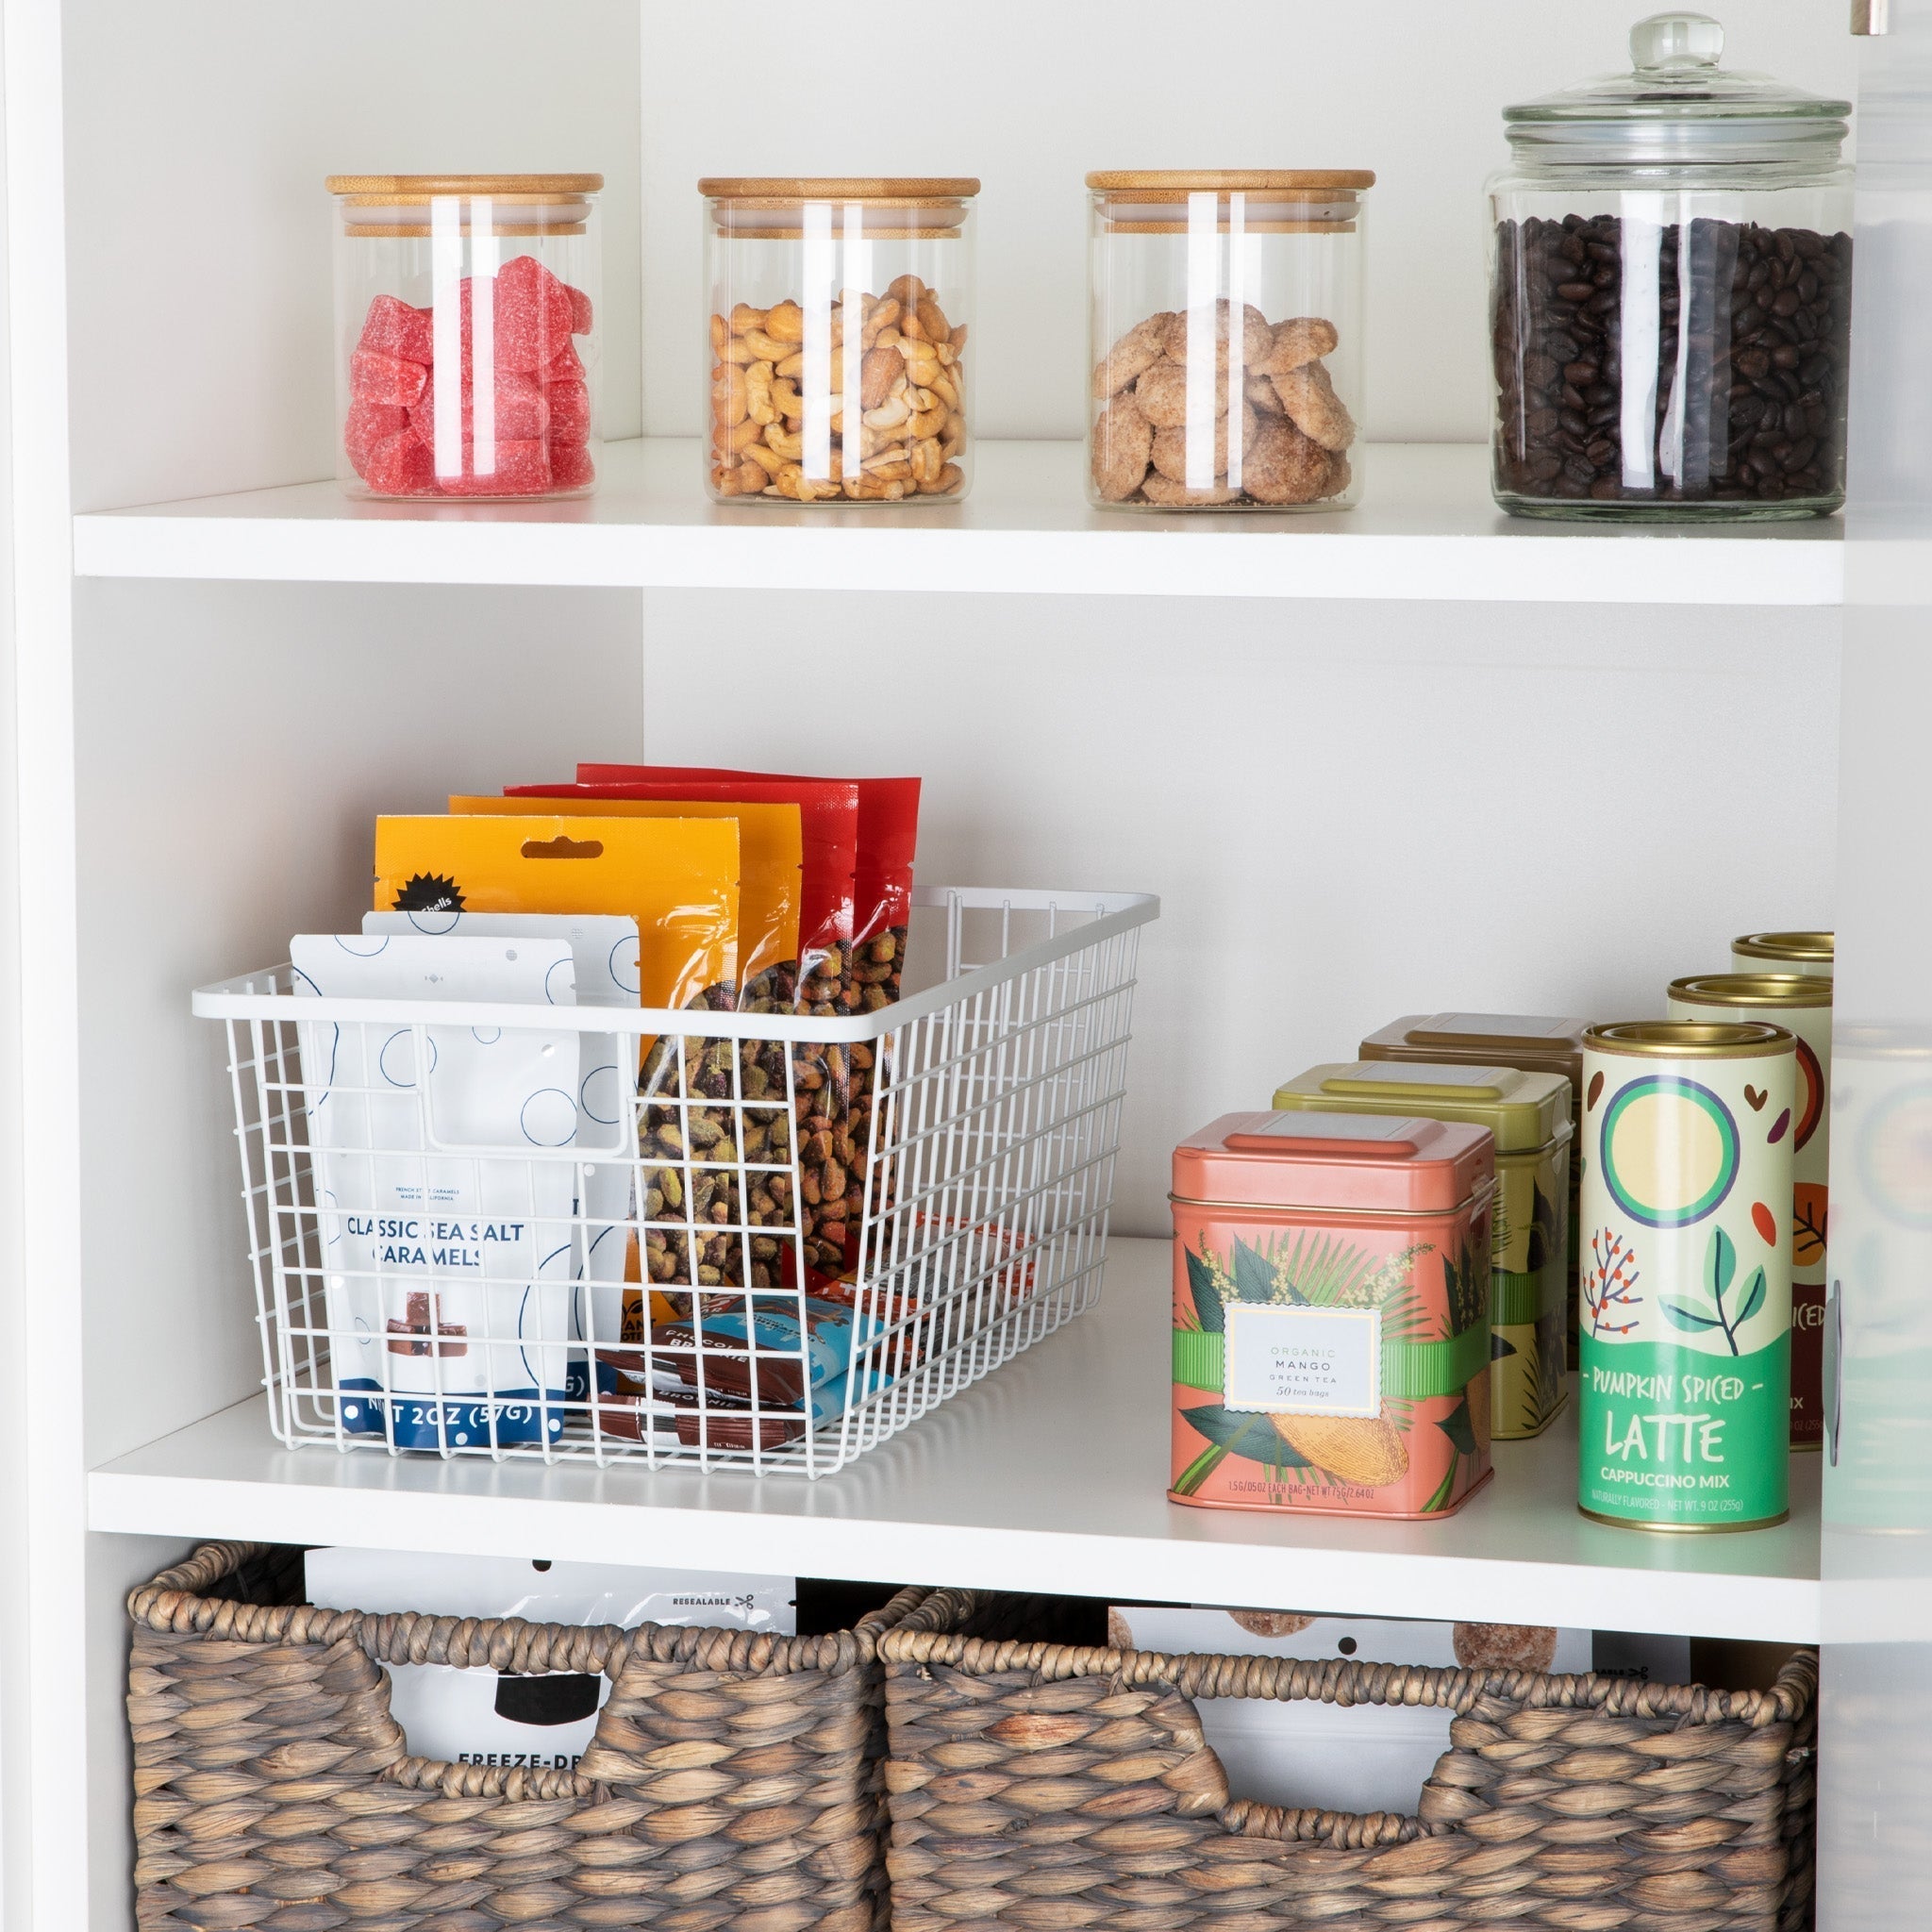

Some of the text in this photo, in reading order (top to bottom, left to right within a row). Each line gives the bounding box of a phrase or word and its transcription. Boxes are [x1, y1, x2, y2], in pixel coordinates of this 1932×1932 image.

[347, 1217, 419, 1239] CLASSIC
[1792, 1303, 1825, 1330] ICED
[1271, 1347, 1336, 1358] ORGANIC
[1275, 1360, 1330, 1371] MANGO
[1276, 1386, 1291, 1397] 50
[1308, 1390, 1329, 1398] bags
[1593, 1366, 1744, 1406] PUMPKIN SPICED
[1790, 1396, 1804, 1409] IX
[1606, 1410, 1726, 1463] LATTE
[1268, 1482, 1286, 1493] EACH
[1601, 1467, 1730, 1489] CAPPUCCINO MIX
[1591, 1489, 1622, 1506] NATURALLY
[1623, 1495, 1660, 1509] FLAVORED
[1667, 1499, 1682, 1511] NET
[1700, 1501, 1707, 1511] 9
[1707, 1500, 1719, 1511] OZ
[1720, 1499, 1744, 1512] (255g)
[458, 1753, 581, 1770] FREEZE-DR
